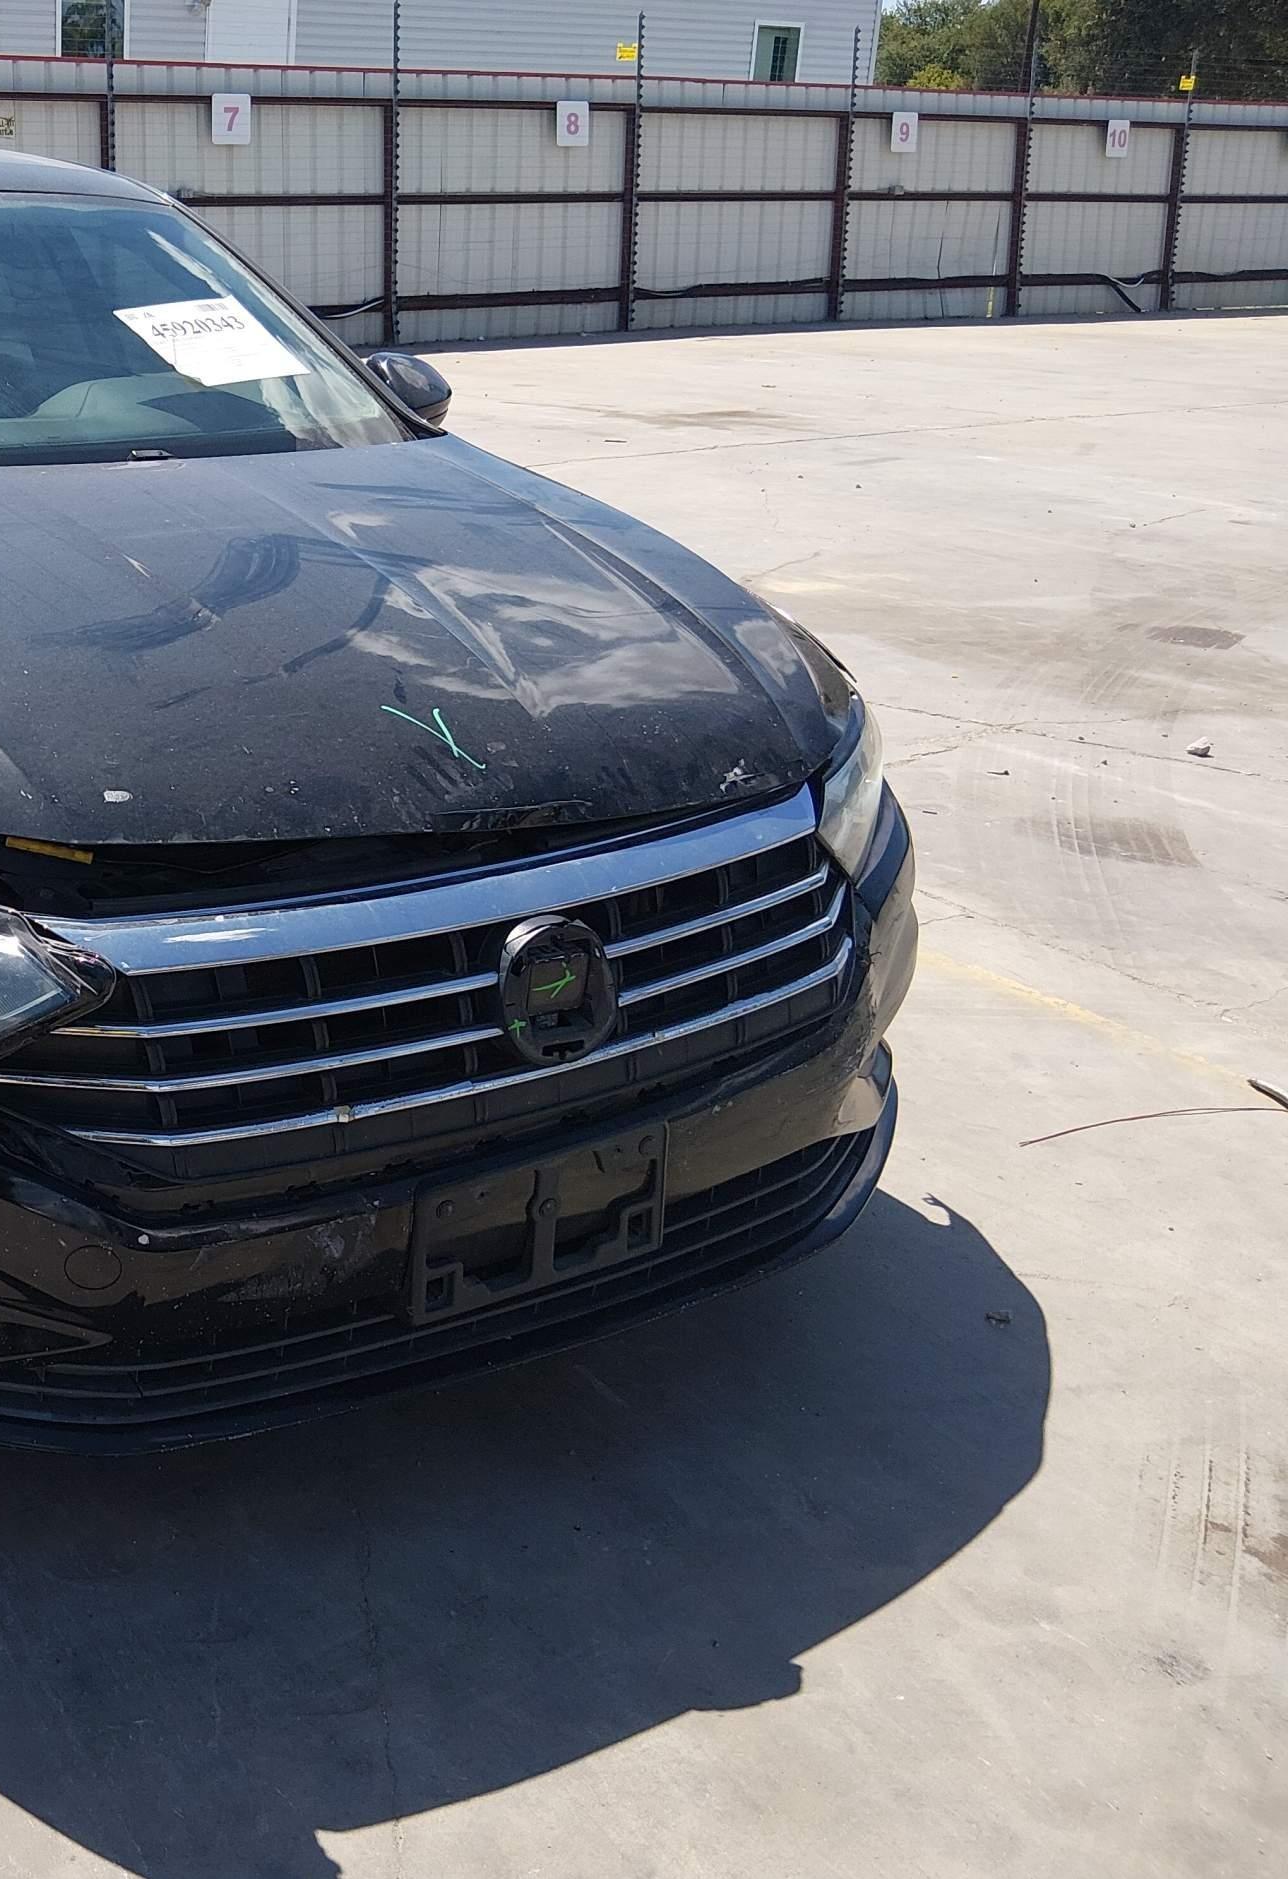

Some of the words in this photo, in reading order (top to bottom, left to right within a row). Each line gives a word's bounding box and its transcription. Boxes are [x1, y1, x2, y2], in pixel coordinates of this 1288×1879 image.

[223, 106, 240, 132] 7
[566, 112, 580, 136] 8
[898, 121, 911, 143] 9
[1108, 128, 1128, 149] 10
[151, 315, 246, 340] 45920343
